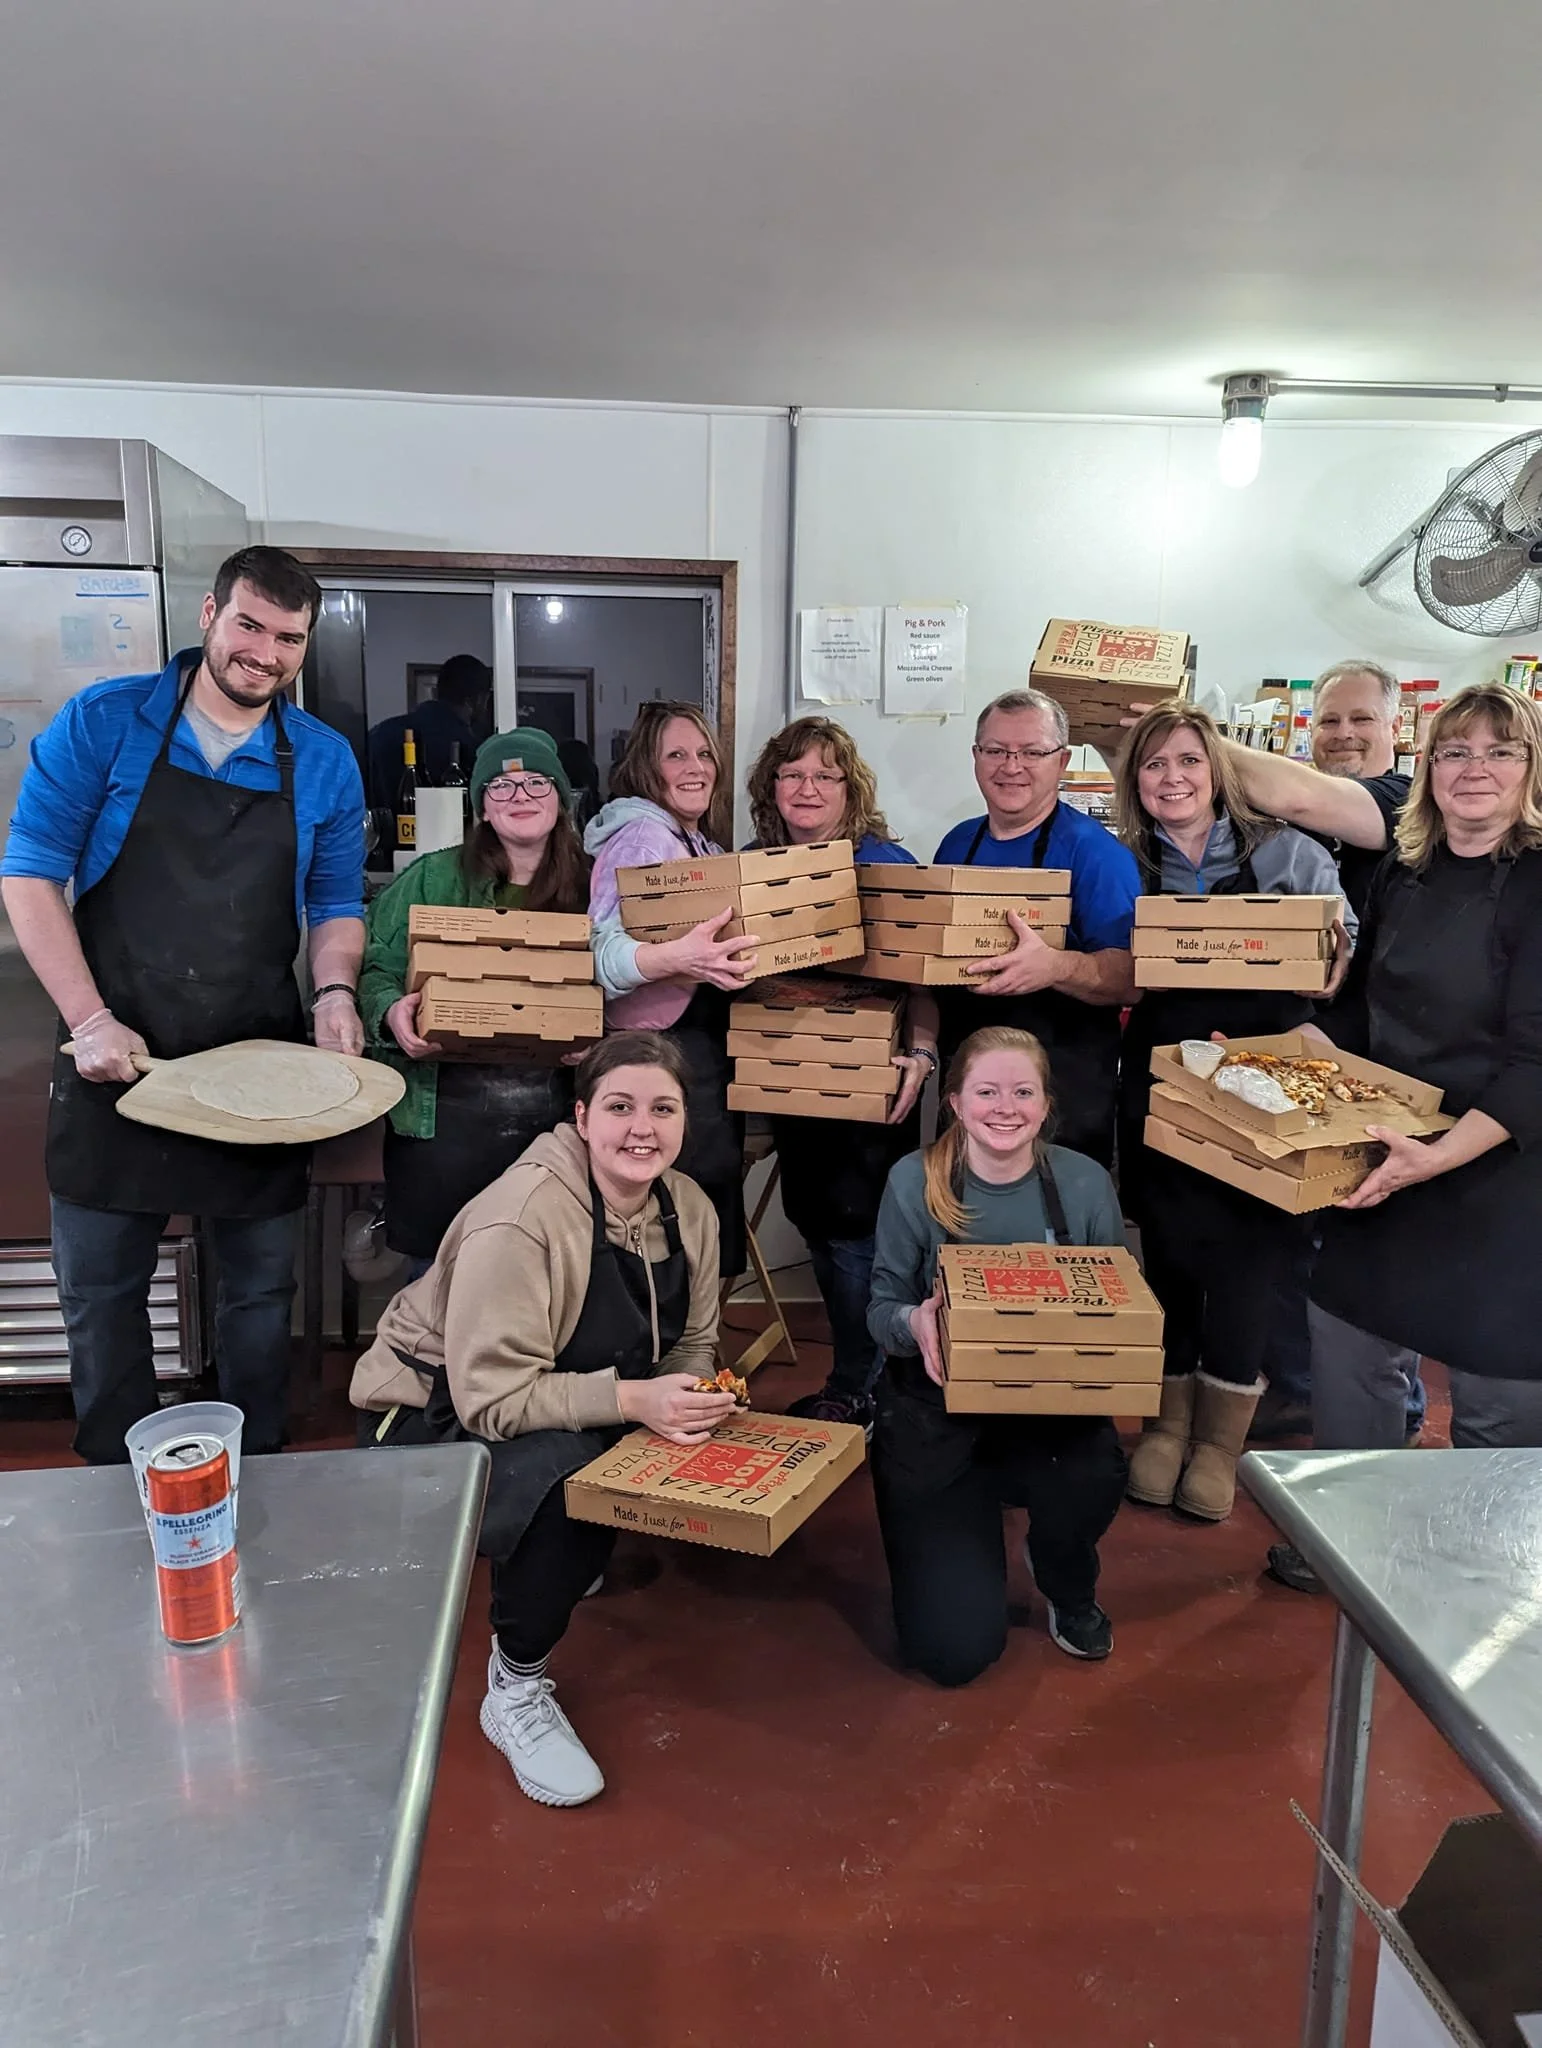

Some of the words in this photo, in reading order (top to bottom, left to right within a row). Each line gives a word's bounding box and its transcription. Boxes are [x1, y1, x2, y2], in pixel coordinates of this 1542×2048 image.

[905, 619, 917, 628] Pig
[919, 619, 925, 627] &
[928, 619, 946, 627] Pork
[1078, 623, 1124, 635] Pizza
[1104, 635, 1154, 648] Hot
[645, 875, 661, 887] Made
[663, 875, 679, 886] Just
[680, 872, 689, 886] for
[984, 908, 999, 919] Made
[974, 937, 991, 949] Made
[993, 938, 1009, 950] Just
[1176, 938, 1199, 950] Made
[1203, 939, 1225, 951] Just
[1227, 939, 1242, 954] for
[774, 953, 791, 966] Made
[793, 952, 808, 963] Just
[808, 948, 819, 962] for
[961, 1267, 989, 1302] PIZZA
[993, 1284, 1062, 1294] Hot
[1069, 1265, 1103, 1297] Pizza
[1043, 1297, 1109, 1306] Pizza
[711, 1428, 800, 1453] Pizza
[681, 1445, 737, 1478] Fresh
[780, 1440, 827, 1470] Pizza
[628, 1451, 686, 1485] Pizza
[711, 1460, 737, 1471] &
[723, 1451, 781, 1486] Hot
[658, 1476, 769, 1506] PIZZA
[613, 1504, 639, 1522] Made
[643, 1512, 668, 1528] Just
[670, 1516, 685, 1533] for
[174, 1523, 212, 1536] ESSENZA
